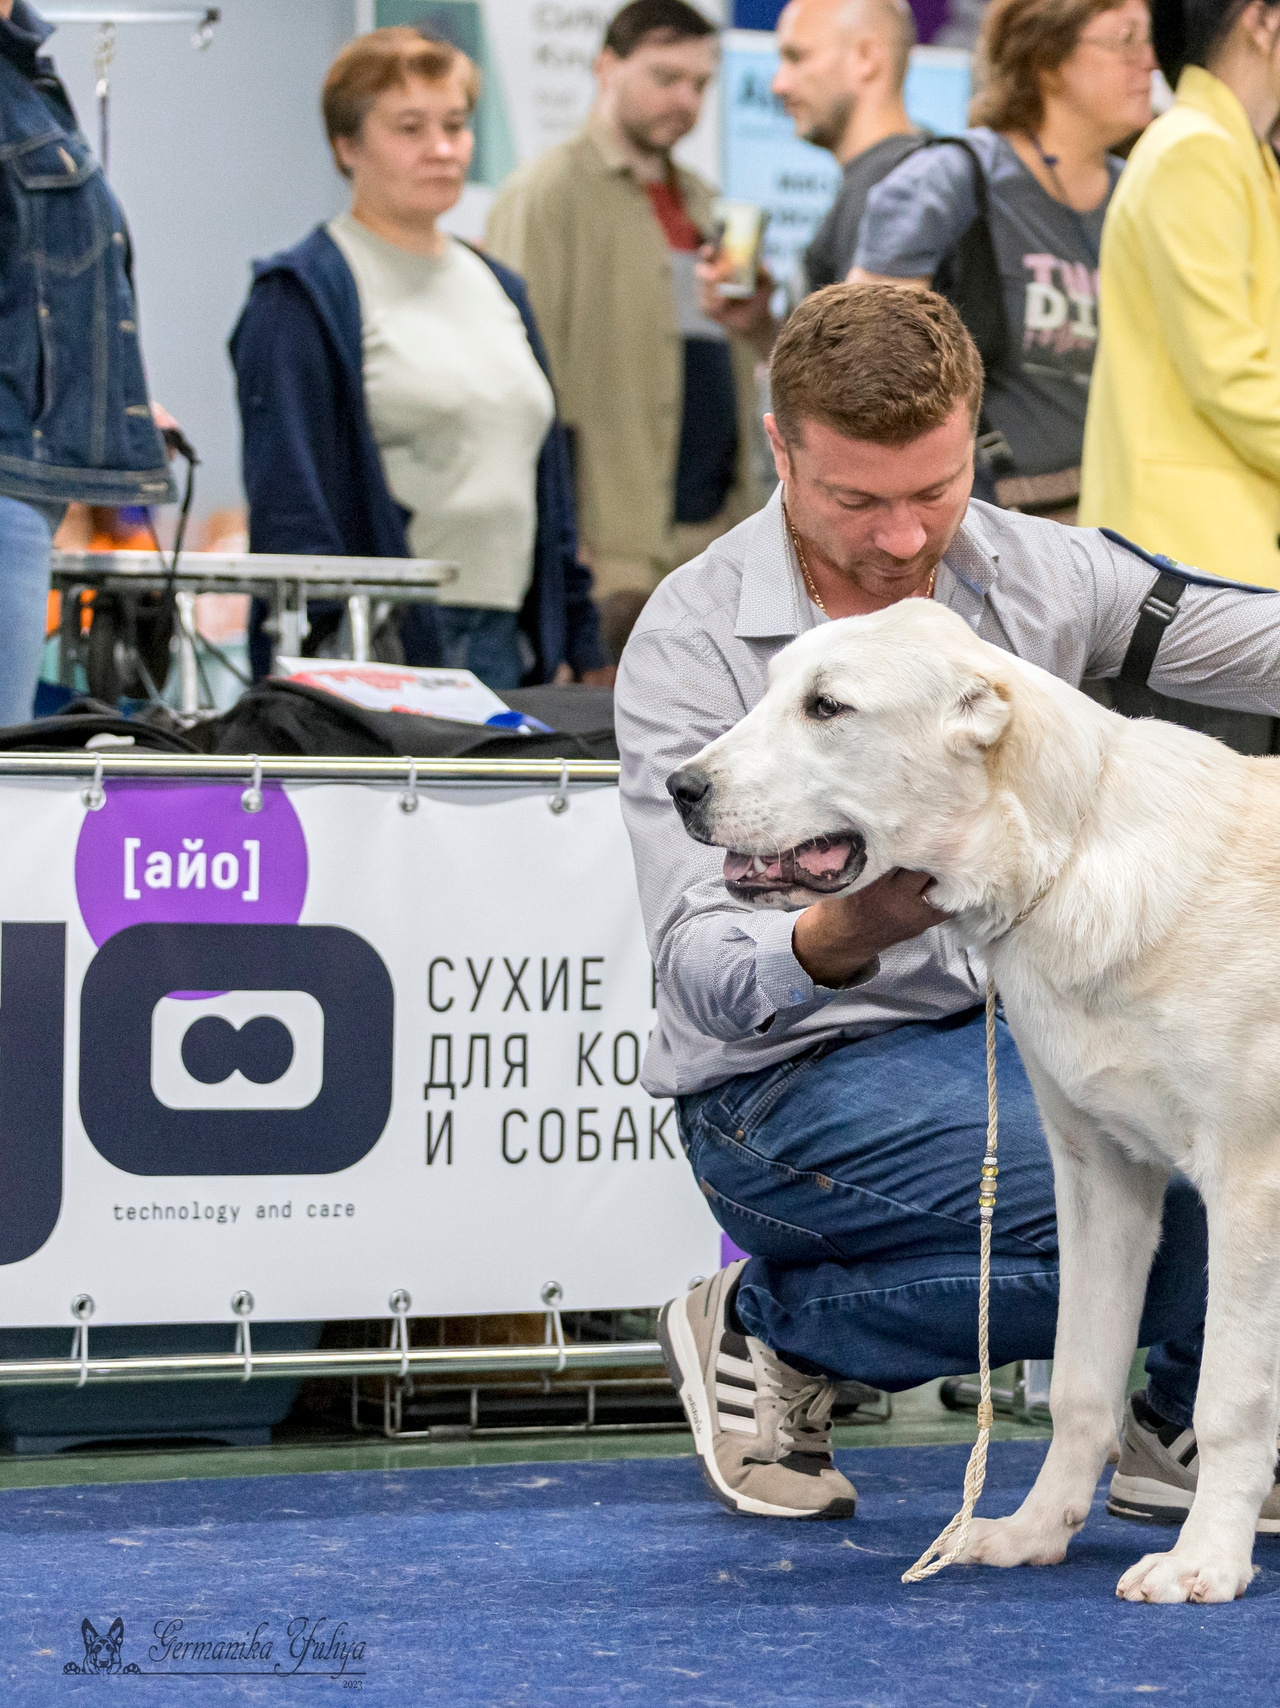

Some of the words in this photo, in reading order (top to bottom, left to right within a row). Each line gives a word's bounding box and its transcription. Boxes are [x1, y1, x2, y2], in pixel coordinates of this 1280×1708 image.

[124, 837, 260, 901] [айо]
[428, 956, 605, 1012] СУХИЕ
[424, 1032, 528, 1100] ДЛЯ
[577, 1030, 654, 1086] КО
[426, 1110, 453, 1165] И
[502, 1105, 676, 1164] СОБАК
[113, 1201, 241, 1224] technology
[256, 1200, 293, 1219] and
[306, 1202, 356, 1218] care
[686, 1393, 700, 1425] adidas
